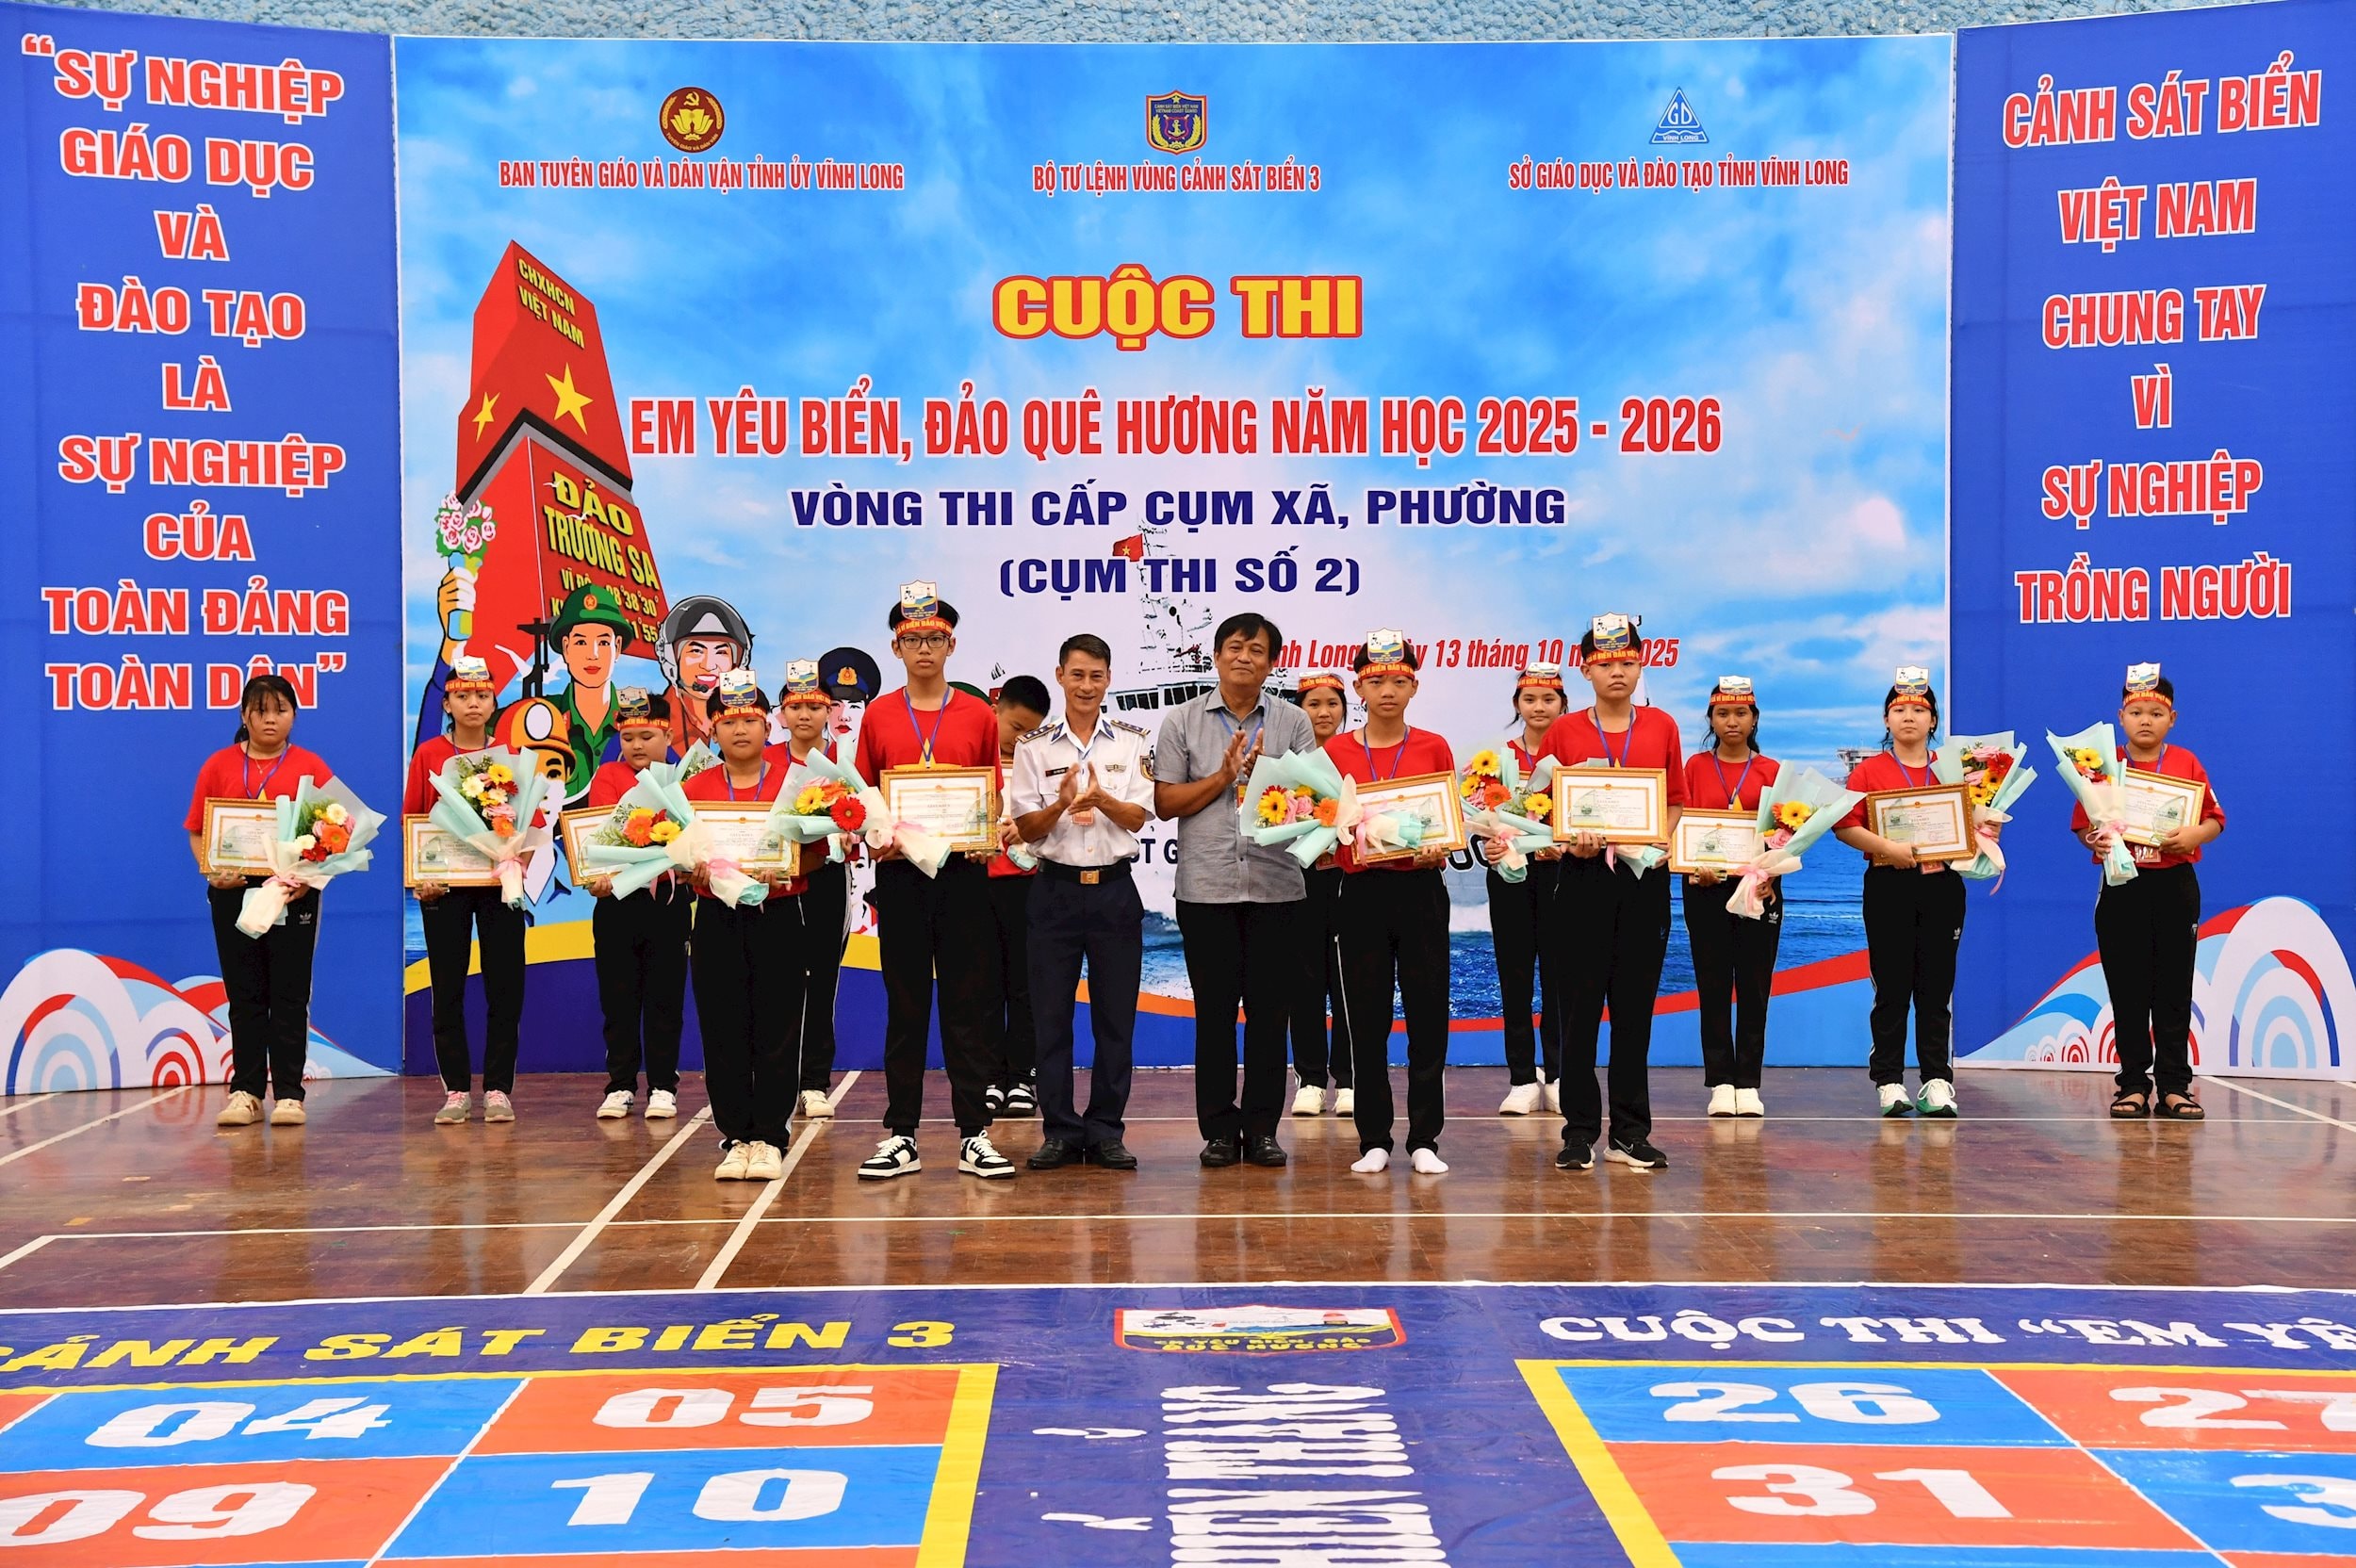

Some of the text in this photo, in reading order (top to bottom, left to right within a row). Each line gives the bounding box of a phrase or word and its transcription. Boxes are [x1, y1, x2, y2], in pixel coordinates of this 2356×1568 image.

[23, 34, 344, 124] “SỰ NGHIỆP
[2002, 50, 2323, 148] CẢNH SÁT BIỂN
[1667, 102, 1693, 124] GD
[60, 122, 313, 197] GIÁO DỤC
[500, 154, 904, 194] BAN TUYÊN GIÁO VÀ DÂN VẬN TỈNH ỦY VĨNH LONG
[1033, 155, 1320, 196] BỘ TƯ LỆNH VÙNG CẢNH SÁT BIỂN 3
[1510, 153, 1849, 193] SỞ GIÁO DỤC VÀ ĐÀO TẠO TỈNH VĨNH LONG
[155, 205, 228, 261] VÀ
[2058, 176, 2257, 253] VIỆT NAM
[76, 277, 305, 348] ĐÀO TẠO
[518, 258, 575, 316] CHXHCN
[518, 285, 584, 349] VIỆT NAM
[993, 264, 1362, 351] CUỘC THI
[2042, 284, 2267, 349] CHUNG TAY
[162, 356, 231, 411] LÀ
[2131, 363, 2171, 430] VÌ
[630, 397, 697, 456] EM
[709, 384, 788, 456] YÊU
[799, 377, 914, 465] BIỂN,
[924, 381, 1008, 456] ĐẢO
[1023, 384, 1105, 461] QUÊ
[1116, 395, 1258, 456] HƯƠNG
[1271, 384, 1368, 456] NĂM
[1382, 398, 1466, 469] HỌC
[1477, 398, 1579, 456] 2025
[1621, 396, 1722, 456] 2026
[58, 433, 345, 498] SỰ NGHIỆP
[2042, 449, 2263, 530] SỰ NGHIỆP
[143, 500, 254, 561] CỦA
[554, 471, 633, 535] ĐẢO
[790, 479, 1566, 532] VÒNG THI CẤP CỤM XÃ, PHƯỜNG
[628, 545, 659, 590] SA
[1000, 545, 1361, 601] (CỤM THI SỐ 2)
[2015, 551, 2292, 624] TRỒNG NGƯỜI
[42, 576, 349, 636] TOÀN ĐẢNG
[46, 656, 192, 710] TOÀN
[1436, 639, 1460, 668] 13
[1467, 639, 1528, 671] tháng
[1538, 639, 1561, 667] 10
[1640, 637, 1678, 667] 025
[303, 1327, 546, 1362] SÁT
[569, 1314, 851, 1353] BIỂN
[887, 1321, 955, 1348] 3
[1539, 1310, 1805, 1349] CUỘC
[1820, 1317, 2006, 1343] THI
[2019, 1317, 2228, 1348] “EM
[85, 1386, 874, 1447] 04 05
[1649, 1382, 1941, 1425] 26
[0, 1468, 848, 1546] 09 10
[1711, 1463, 2014, 1518] 31
